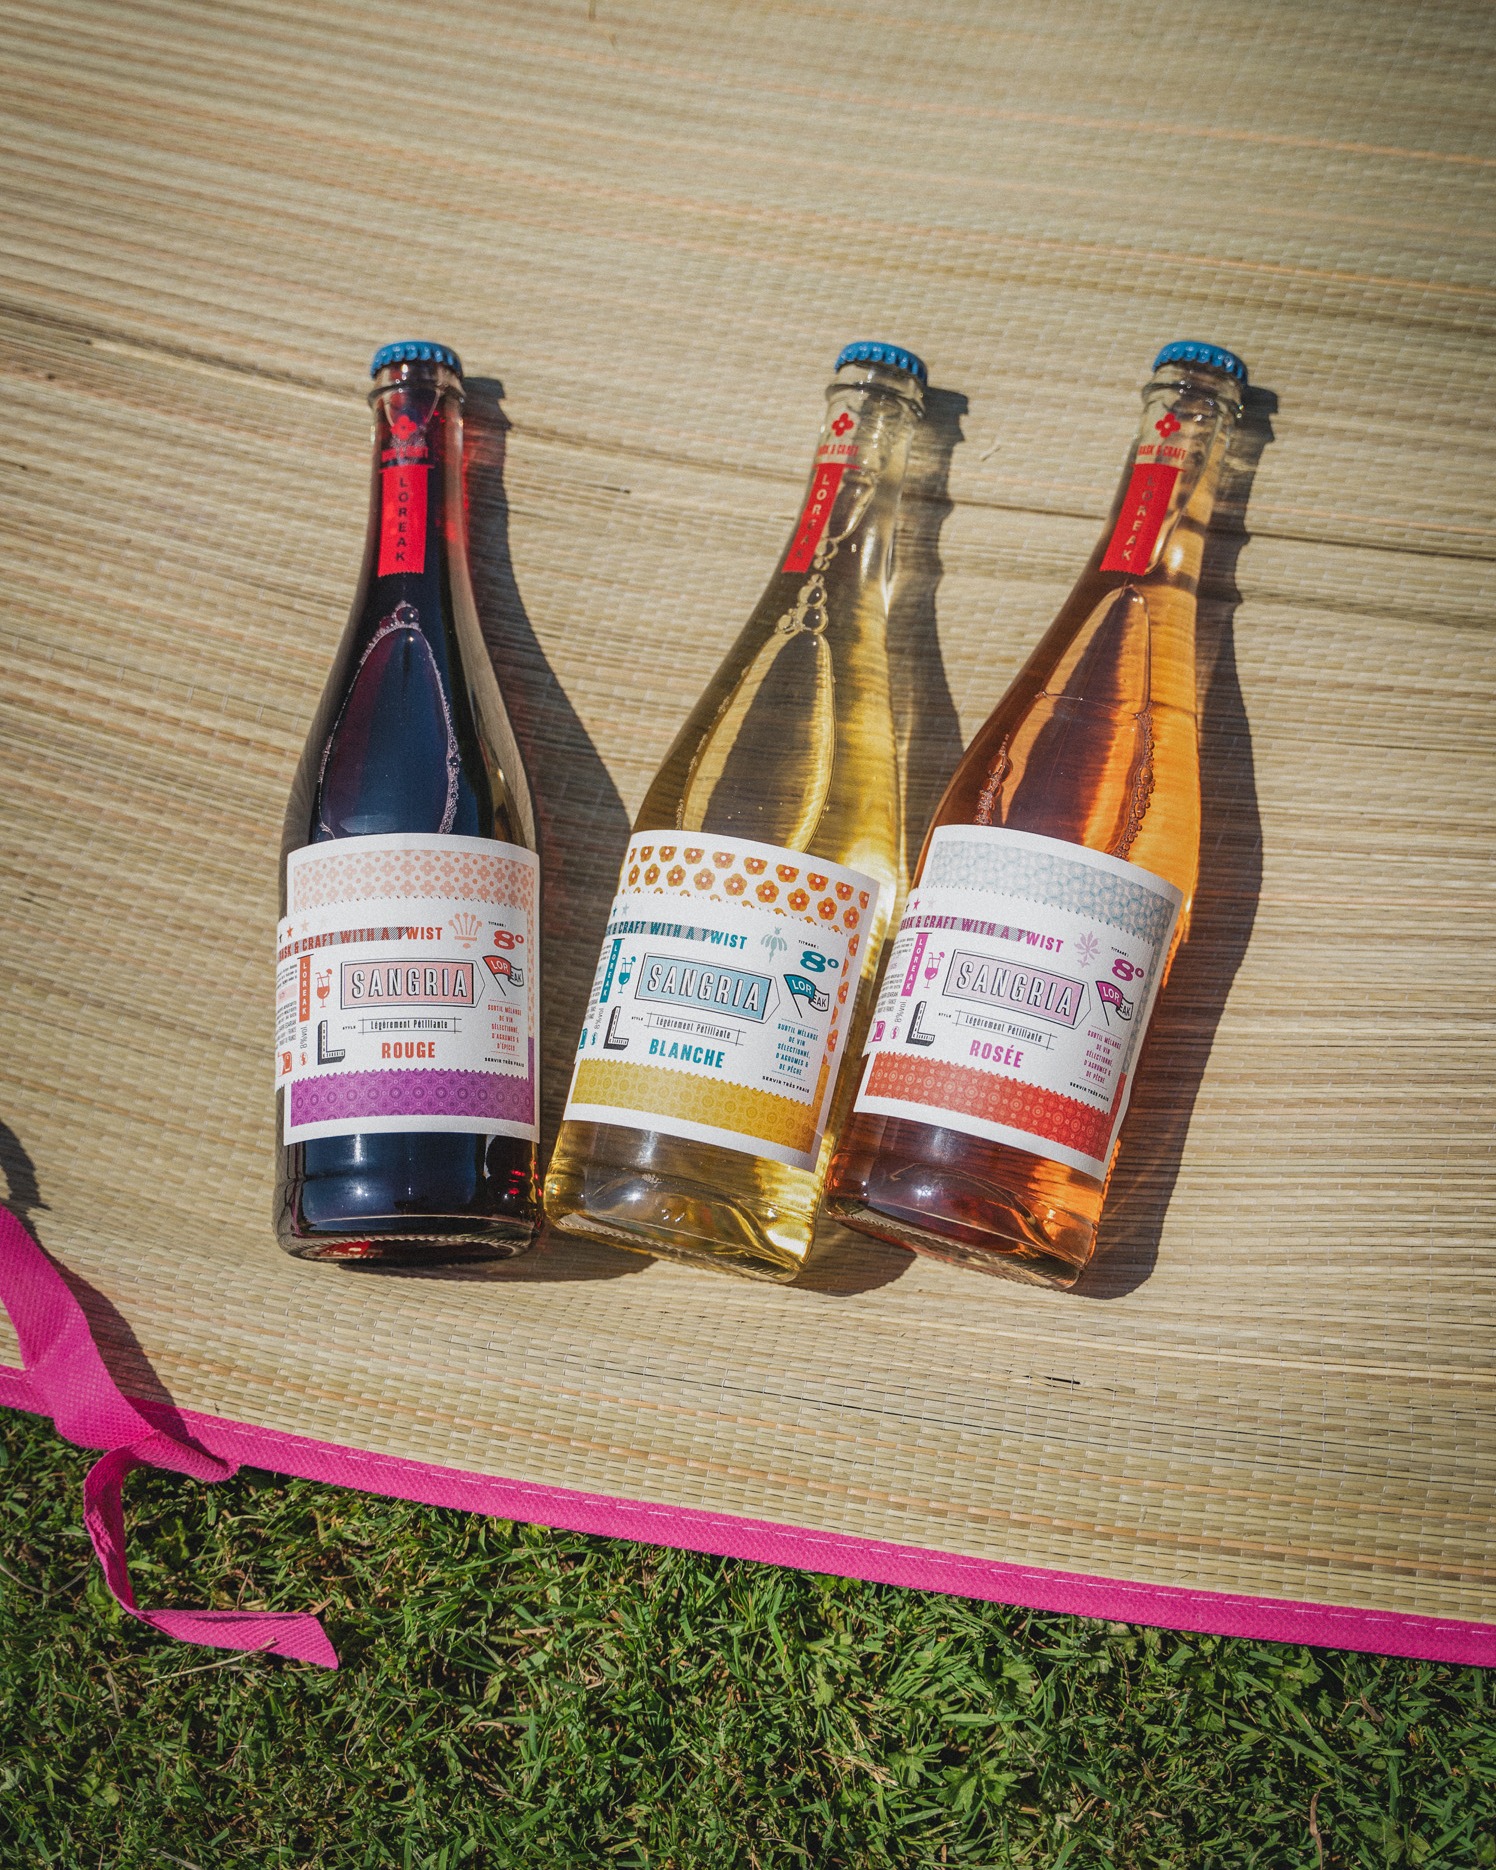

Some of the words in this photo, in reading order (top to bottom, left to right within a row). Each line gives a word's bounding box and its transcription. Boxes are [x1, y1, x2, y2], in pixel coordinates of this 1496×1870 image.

[303, 932, 334, 950] CRAFT
[340, 929, 375, 943] WITH
[382, 928, 390, 940] A
[397, 926, 442, 940] TWIST
[618, 921, 646, 934] CRAFT
[650, 922, 682, 937] WITH
[686, 927, 695, 940] A
[702, 928, 748, 950] TWIST
[924, 916, 958, 930] CRAFT
[962, 918, 996, 936] WITH
[1000, 926, 1010, 939] A
[1017, 928, 1064, 953] TWIST
[906, 938, 923, 990] LOREAK
[352, 968, 468, 998] SANGRIA
[648, 964, 760, 1011] SANGRIA
[957, 961, 1072, 1016] SANGRIA
[414, 1019, 448, 1028] Pétillante
[696, 1022, 731, 1039] Pétillante
[1008, 1024, 1042, 1042] Pétillante
[382, 1042, 436, 1058] ROUGE
[649, 1038, 726, 1068] BLANCHE
[969, 1040, 1024, 1068] ROSÉE
